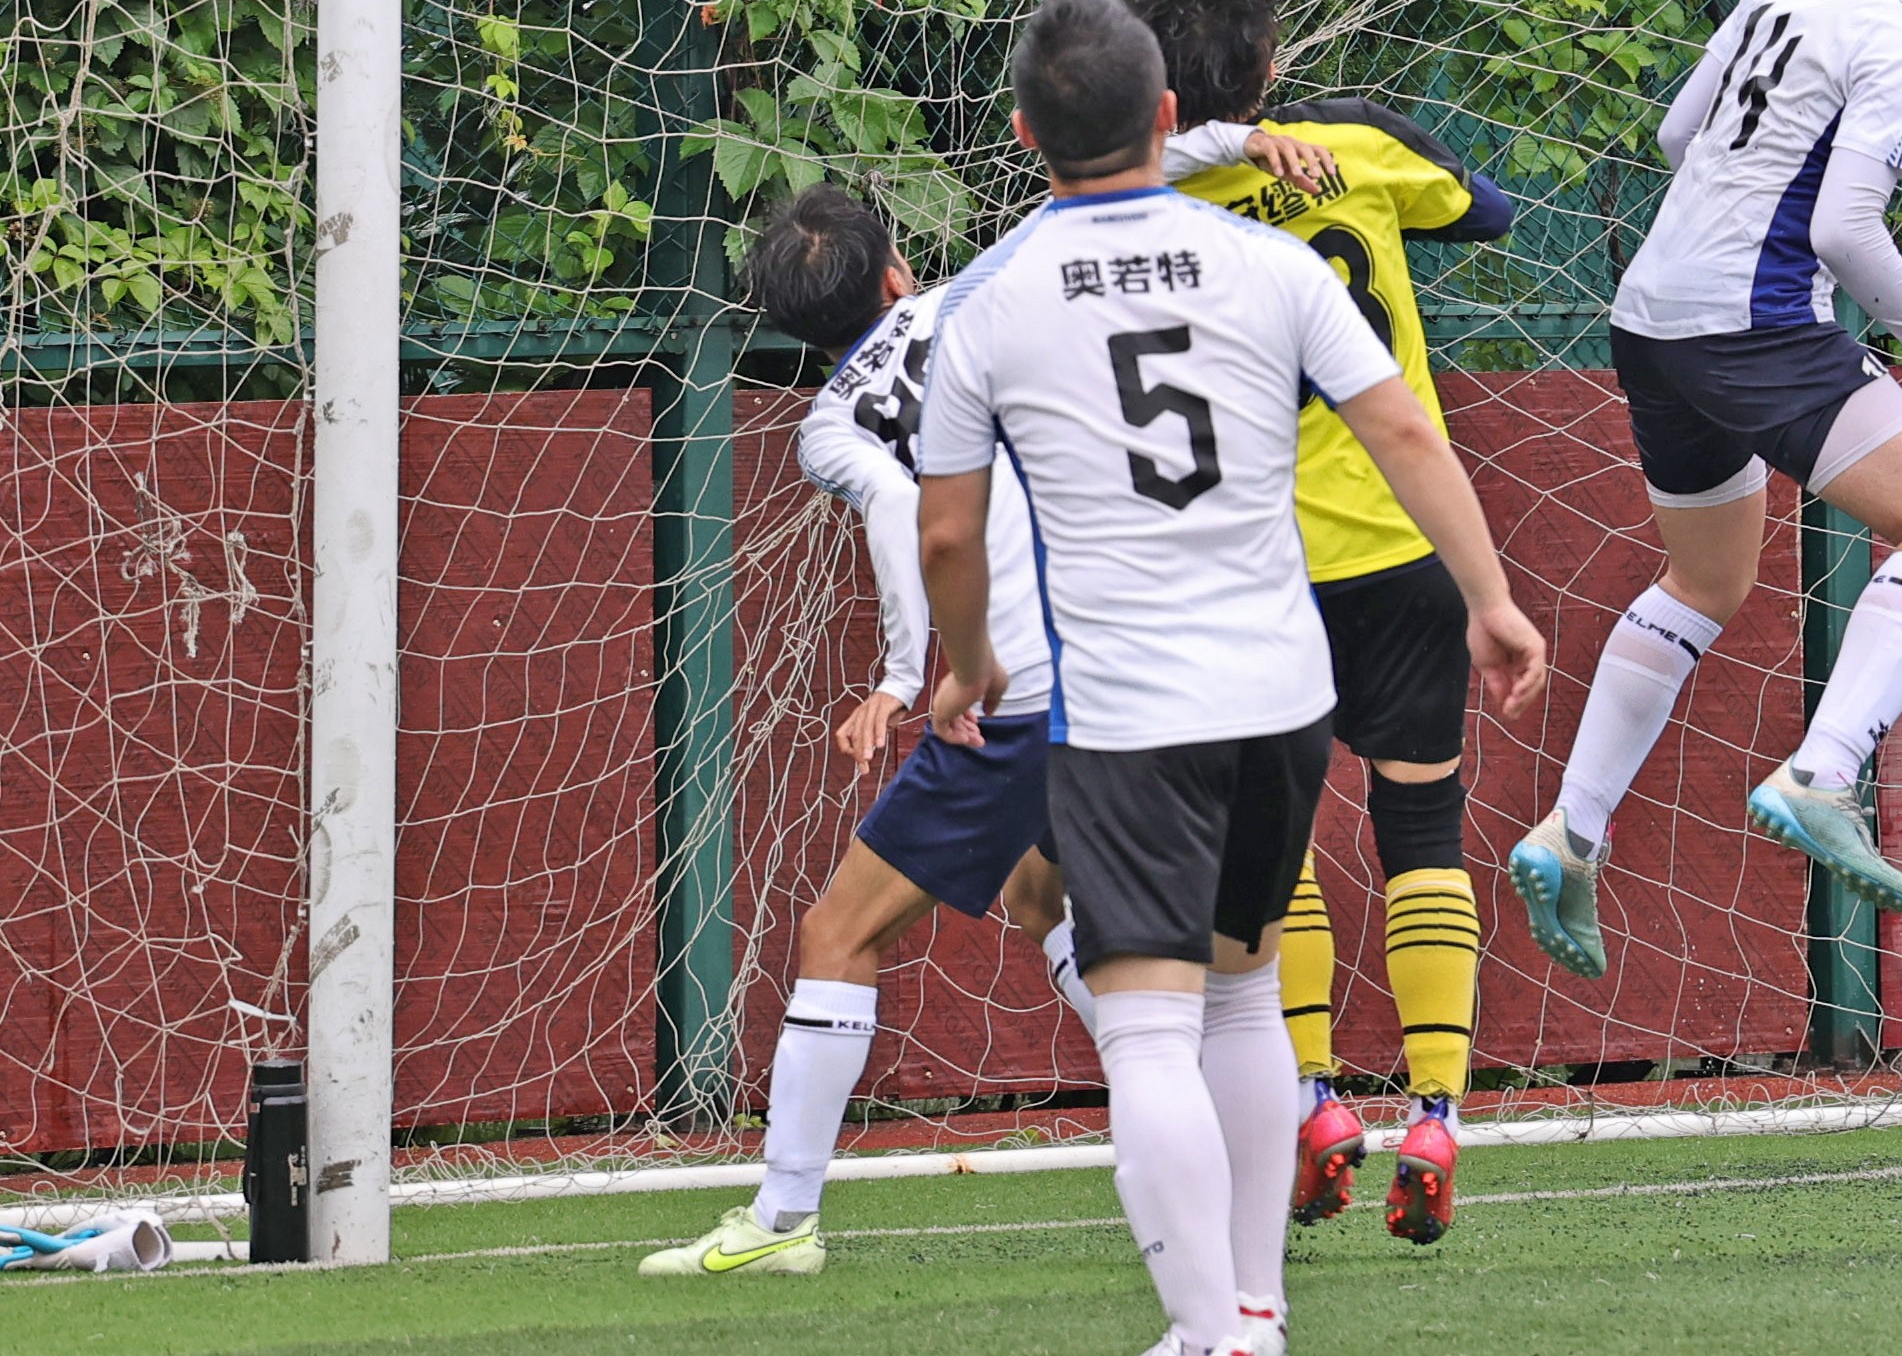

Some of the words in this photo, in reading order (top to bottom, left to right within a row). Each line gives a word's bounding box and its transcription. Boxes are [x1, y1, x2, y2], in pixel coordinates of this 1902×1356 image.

[1060, 250, 1203, 301] 奥若特
[1107, 323, 1222, 511] 5
